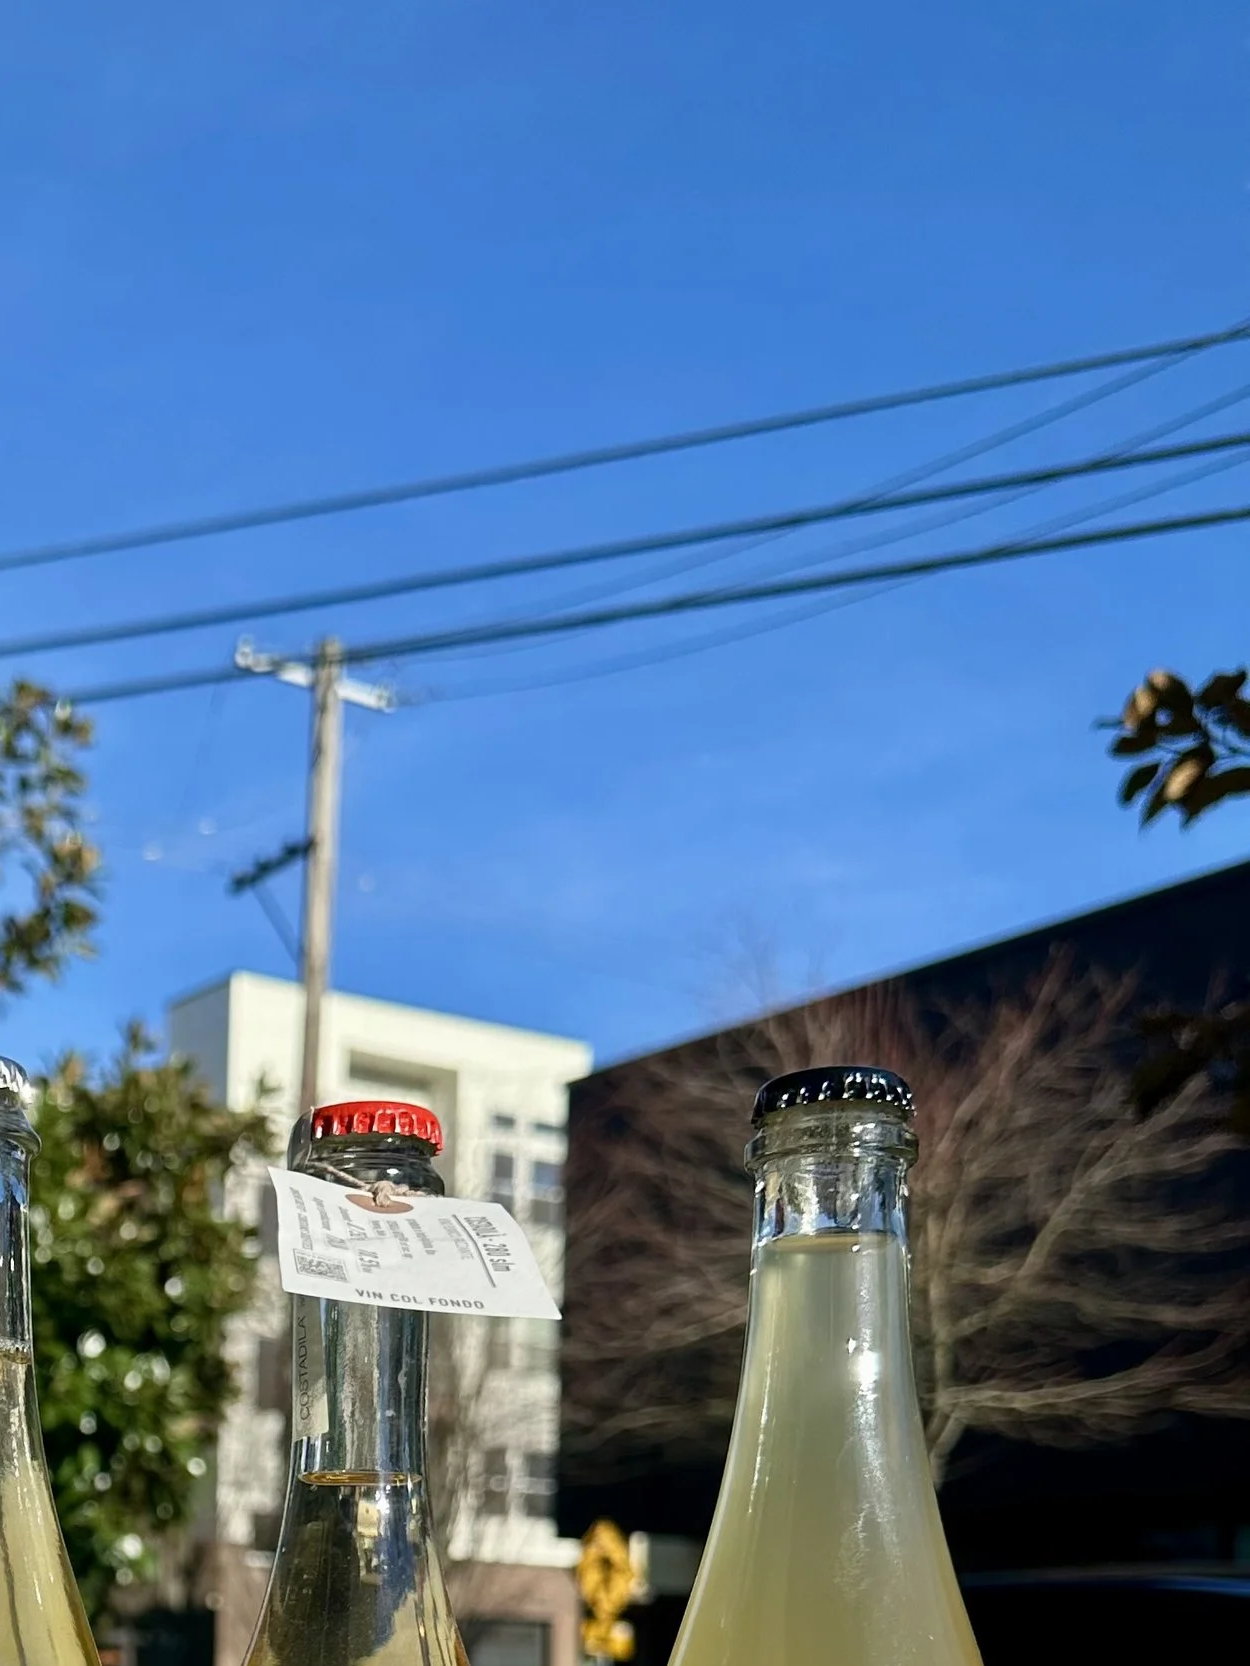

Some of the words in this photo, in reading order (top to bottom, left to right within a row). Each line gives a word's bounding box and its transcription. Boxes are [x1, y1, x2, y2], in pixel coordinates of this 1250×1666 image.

[355, 1288, 383, 1300] VIN
[390, 1293, 423, 1305] COL
[428, 1297, 485, 1309] FONDO
